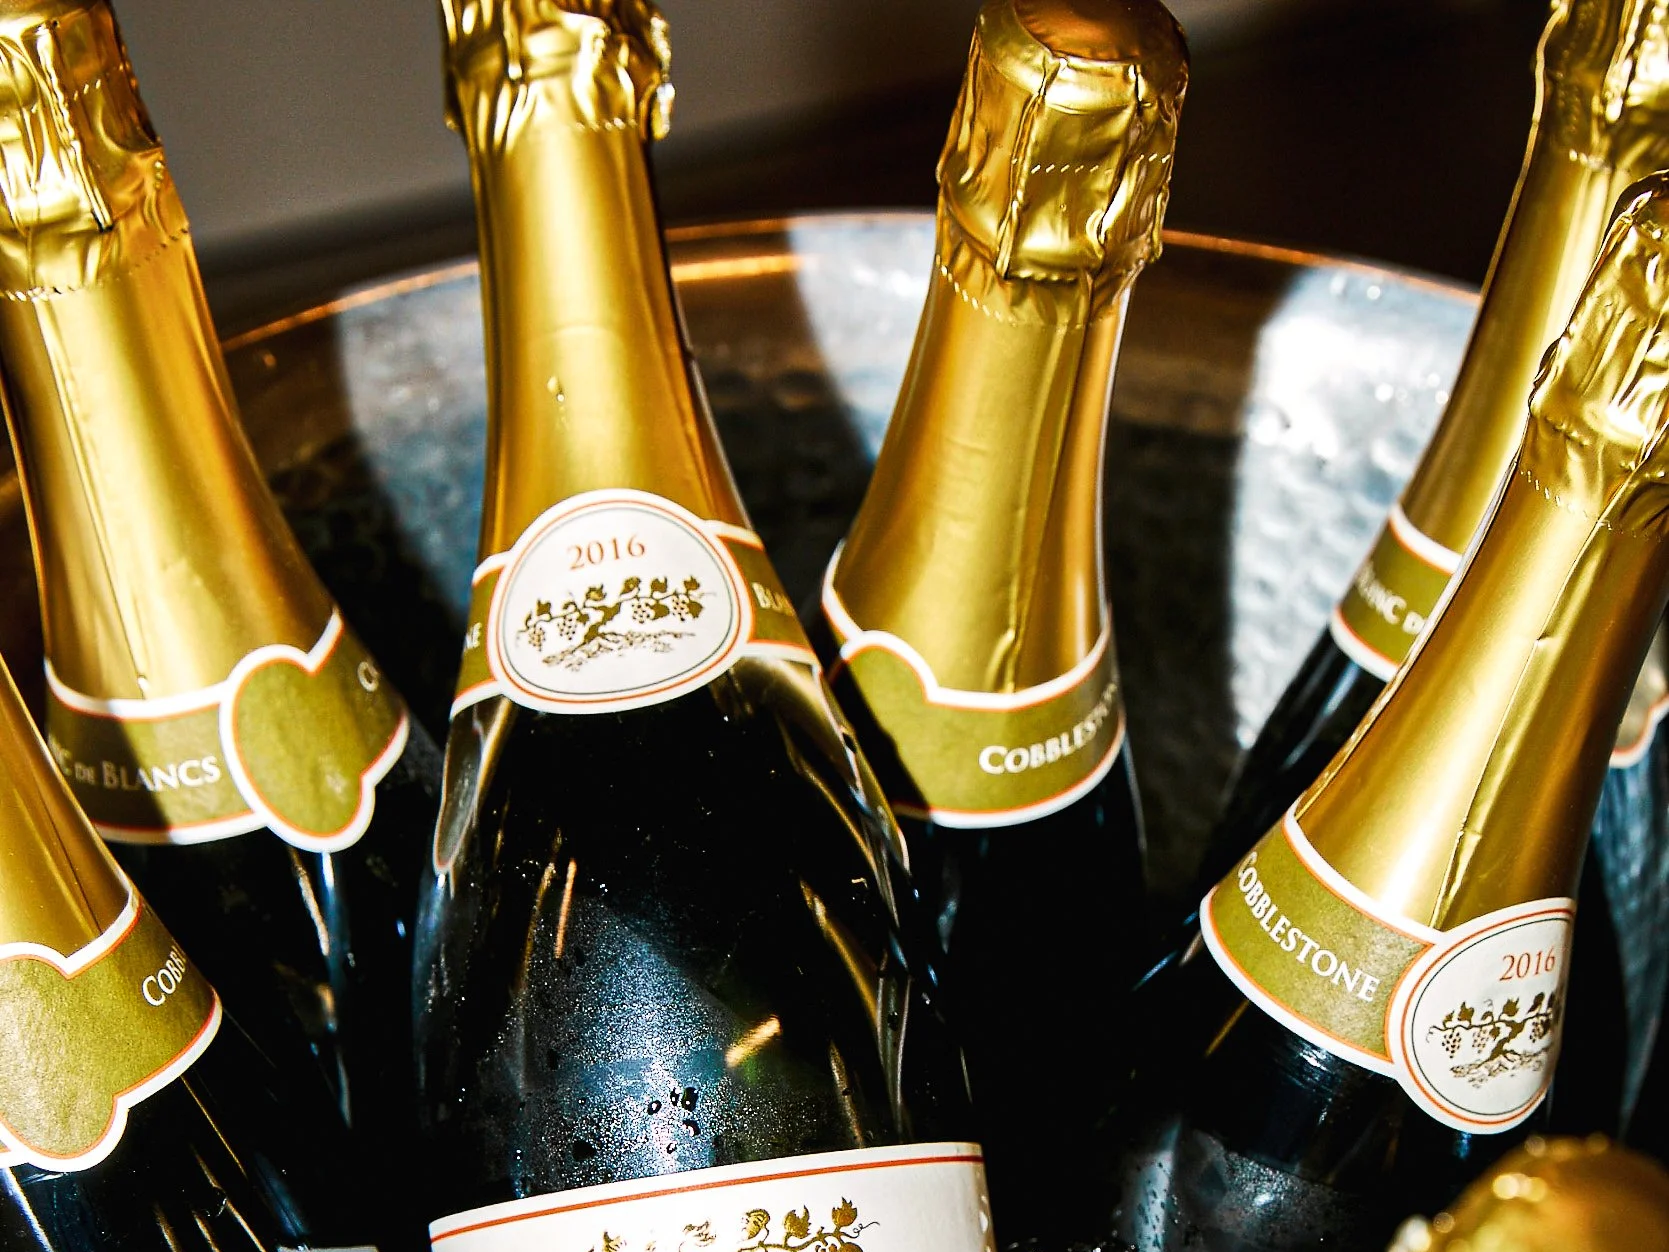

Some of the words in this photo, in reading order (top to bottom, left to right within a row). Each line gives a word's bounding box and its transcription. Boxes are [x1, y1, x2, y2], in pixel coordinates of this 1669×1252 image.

[567, 533, 647, 571] 2016
[102, 755, 222, 793] BLANCS
[1237, 851, 1381, 1003] COBBLESTONE
[1499, 947, 1556, 982] 2016
